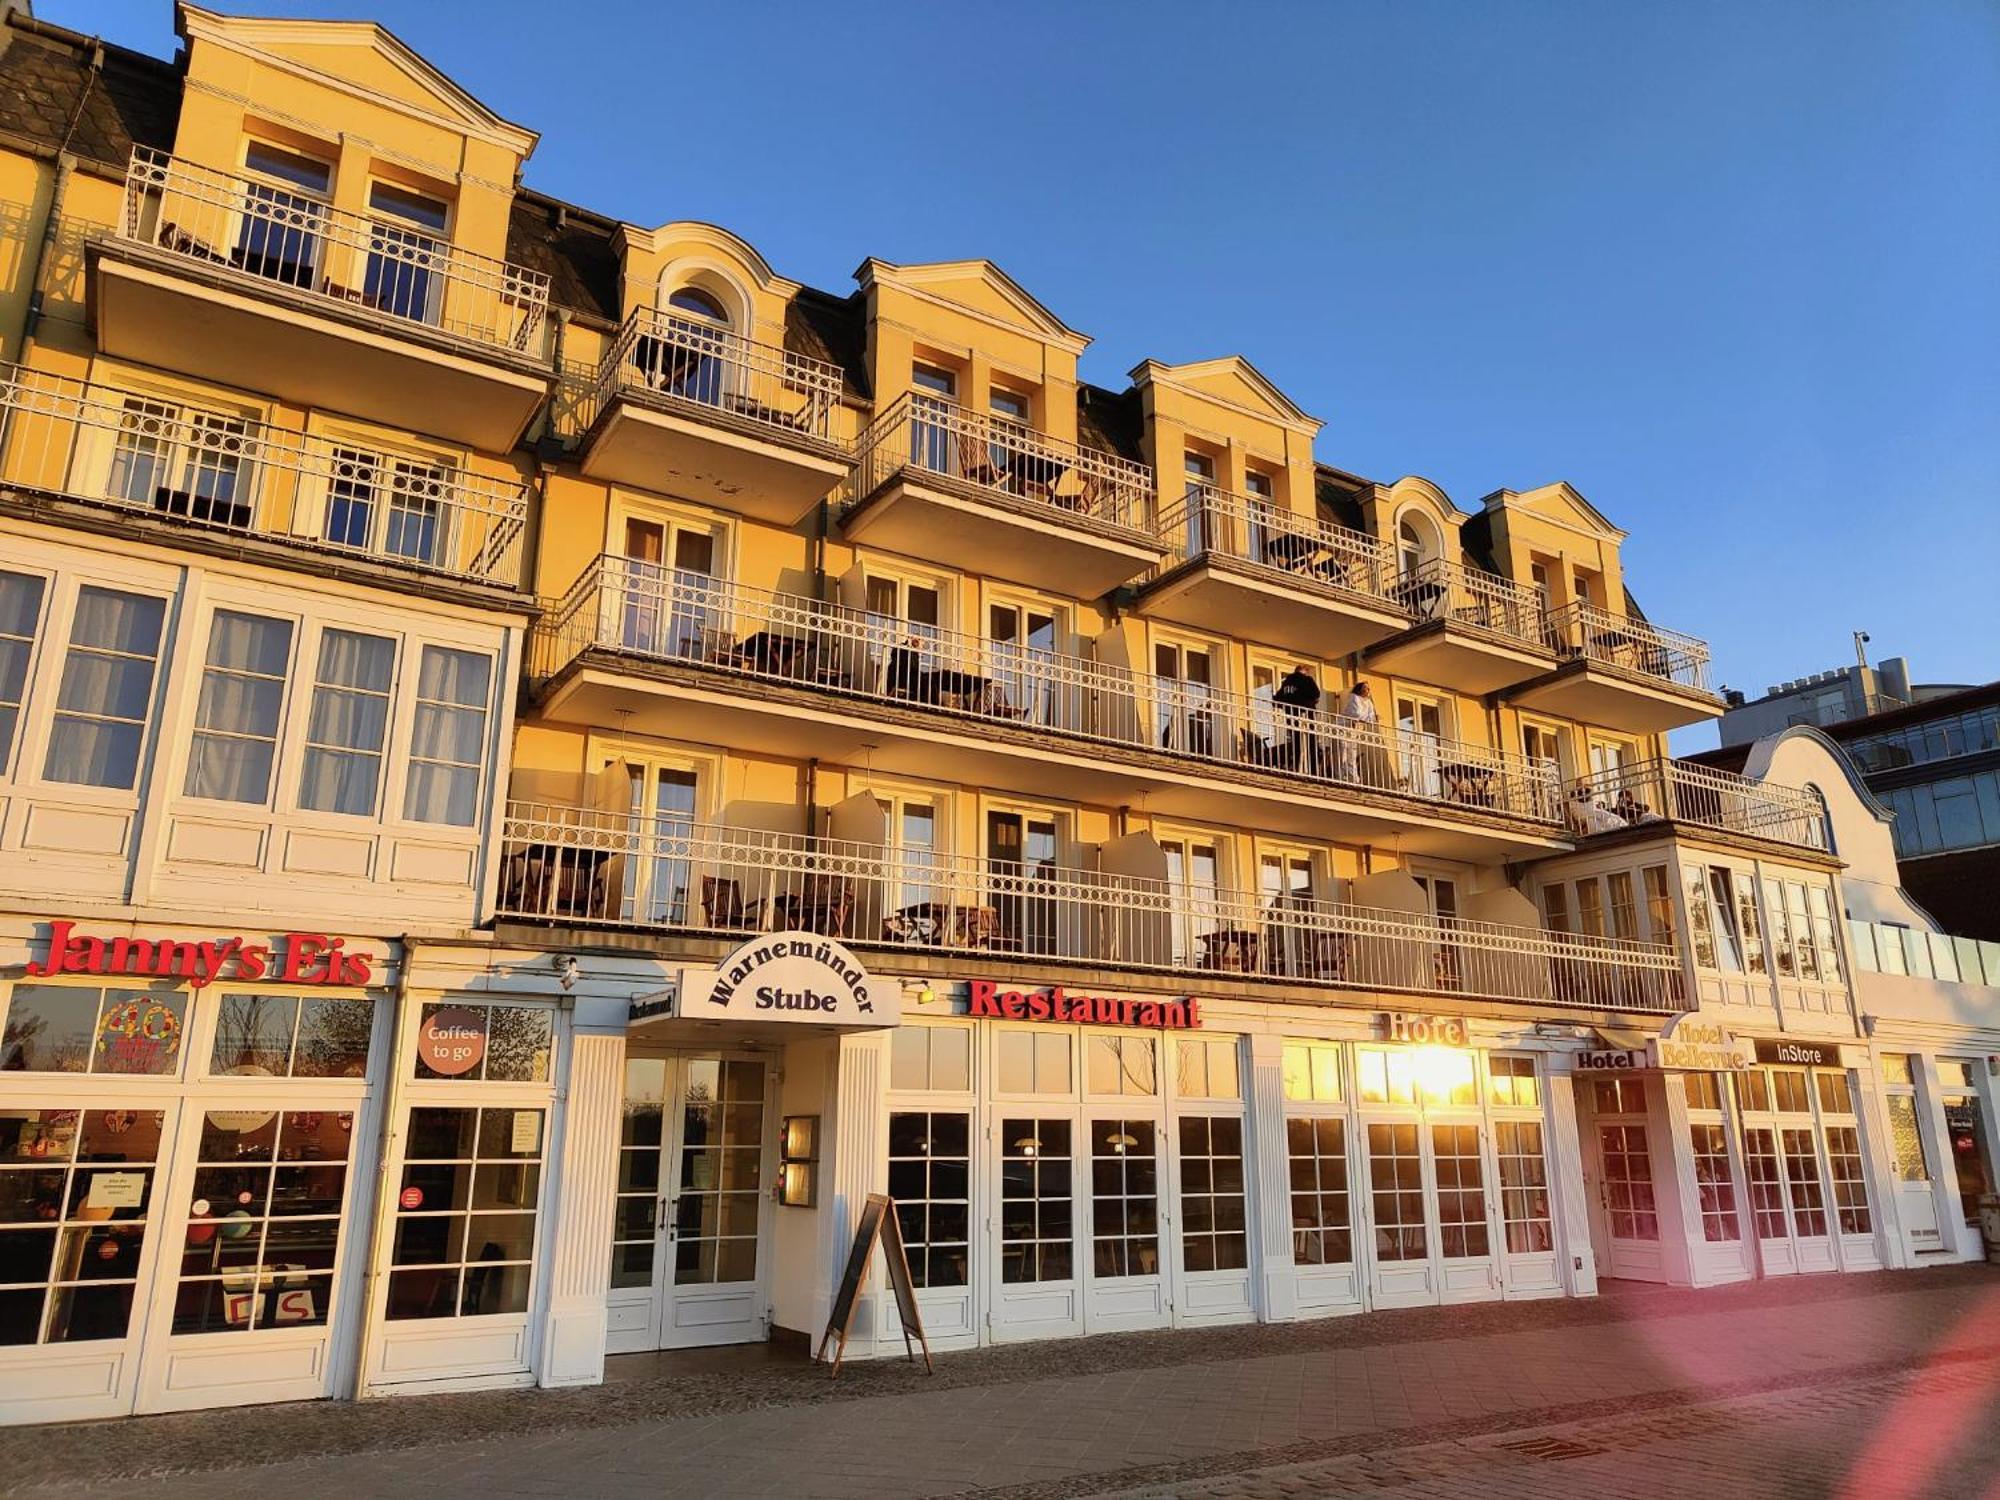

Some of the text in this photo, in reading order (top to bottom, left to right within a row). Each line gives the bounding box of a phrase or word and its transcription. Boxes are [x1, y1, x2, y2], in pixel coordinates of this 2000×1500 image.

[26, 920, 373, 988] Janny's Eis
[708, 940, 873, 1015] Warnemünder
[755, 986, 837, 1012] Stube
[970, 980, 1202, 1028] Restaurant
[427, 1025, 479, 1040] Coffee
[1390, 1012, 1470, 1046] Hotel
[1678, 1023, 1723, 1045] Hotel
[433, 1045, 472, 1061] to go
[1577, 1051, 1635, 1068] Hotel
[1661, 1043, 1745, 1070] Bellevue
[1776, 1043, 1822, 1063] InStore
